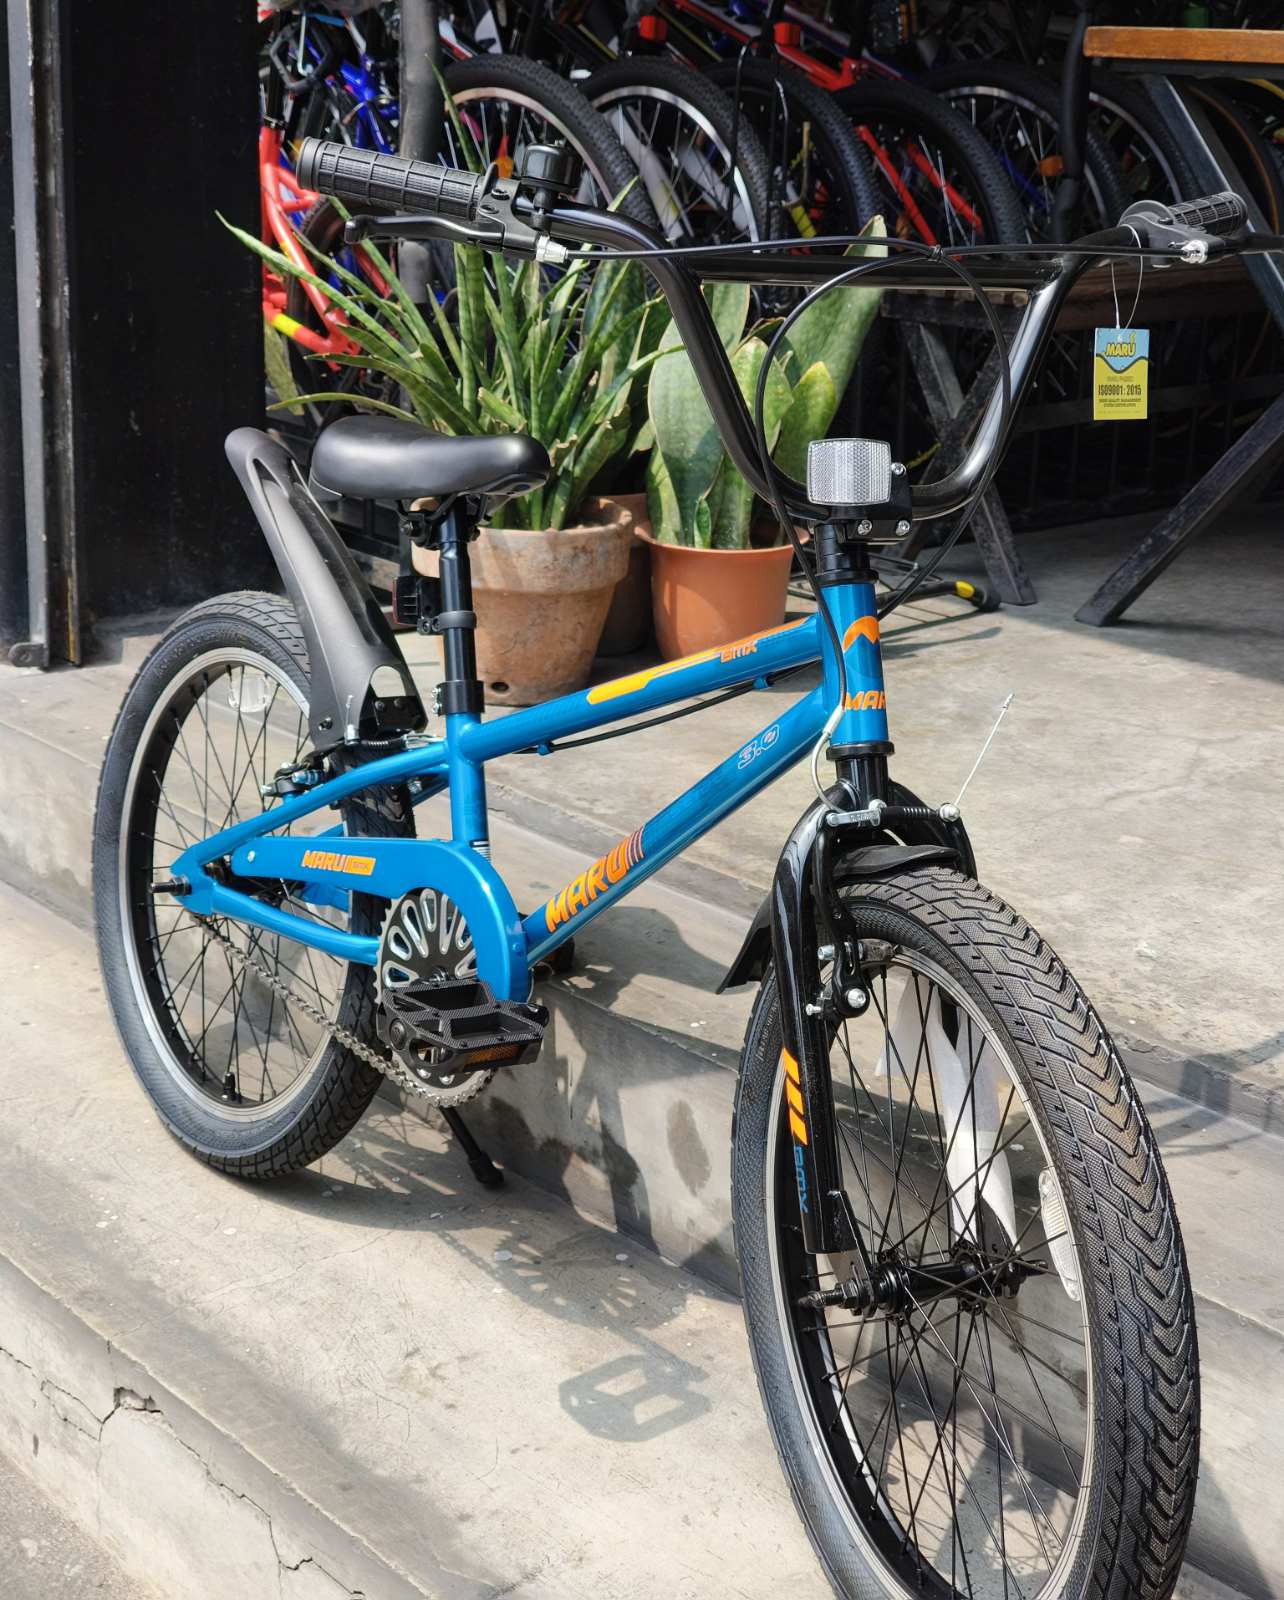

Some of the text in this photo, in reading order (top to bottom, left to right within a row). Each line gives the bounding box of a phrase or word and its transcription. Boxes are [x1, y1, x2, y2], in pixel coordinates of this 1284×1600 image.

[738, 724, 780, 770] 3.0
[301, 849, 346, 872] MARU
[545, 836, 630, 933] MARU
